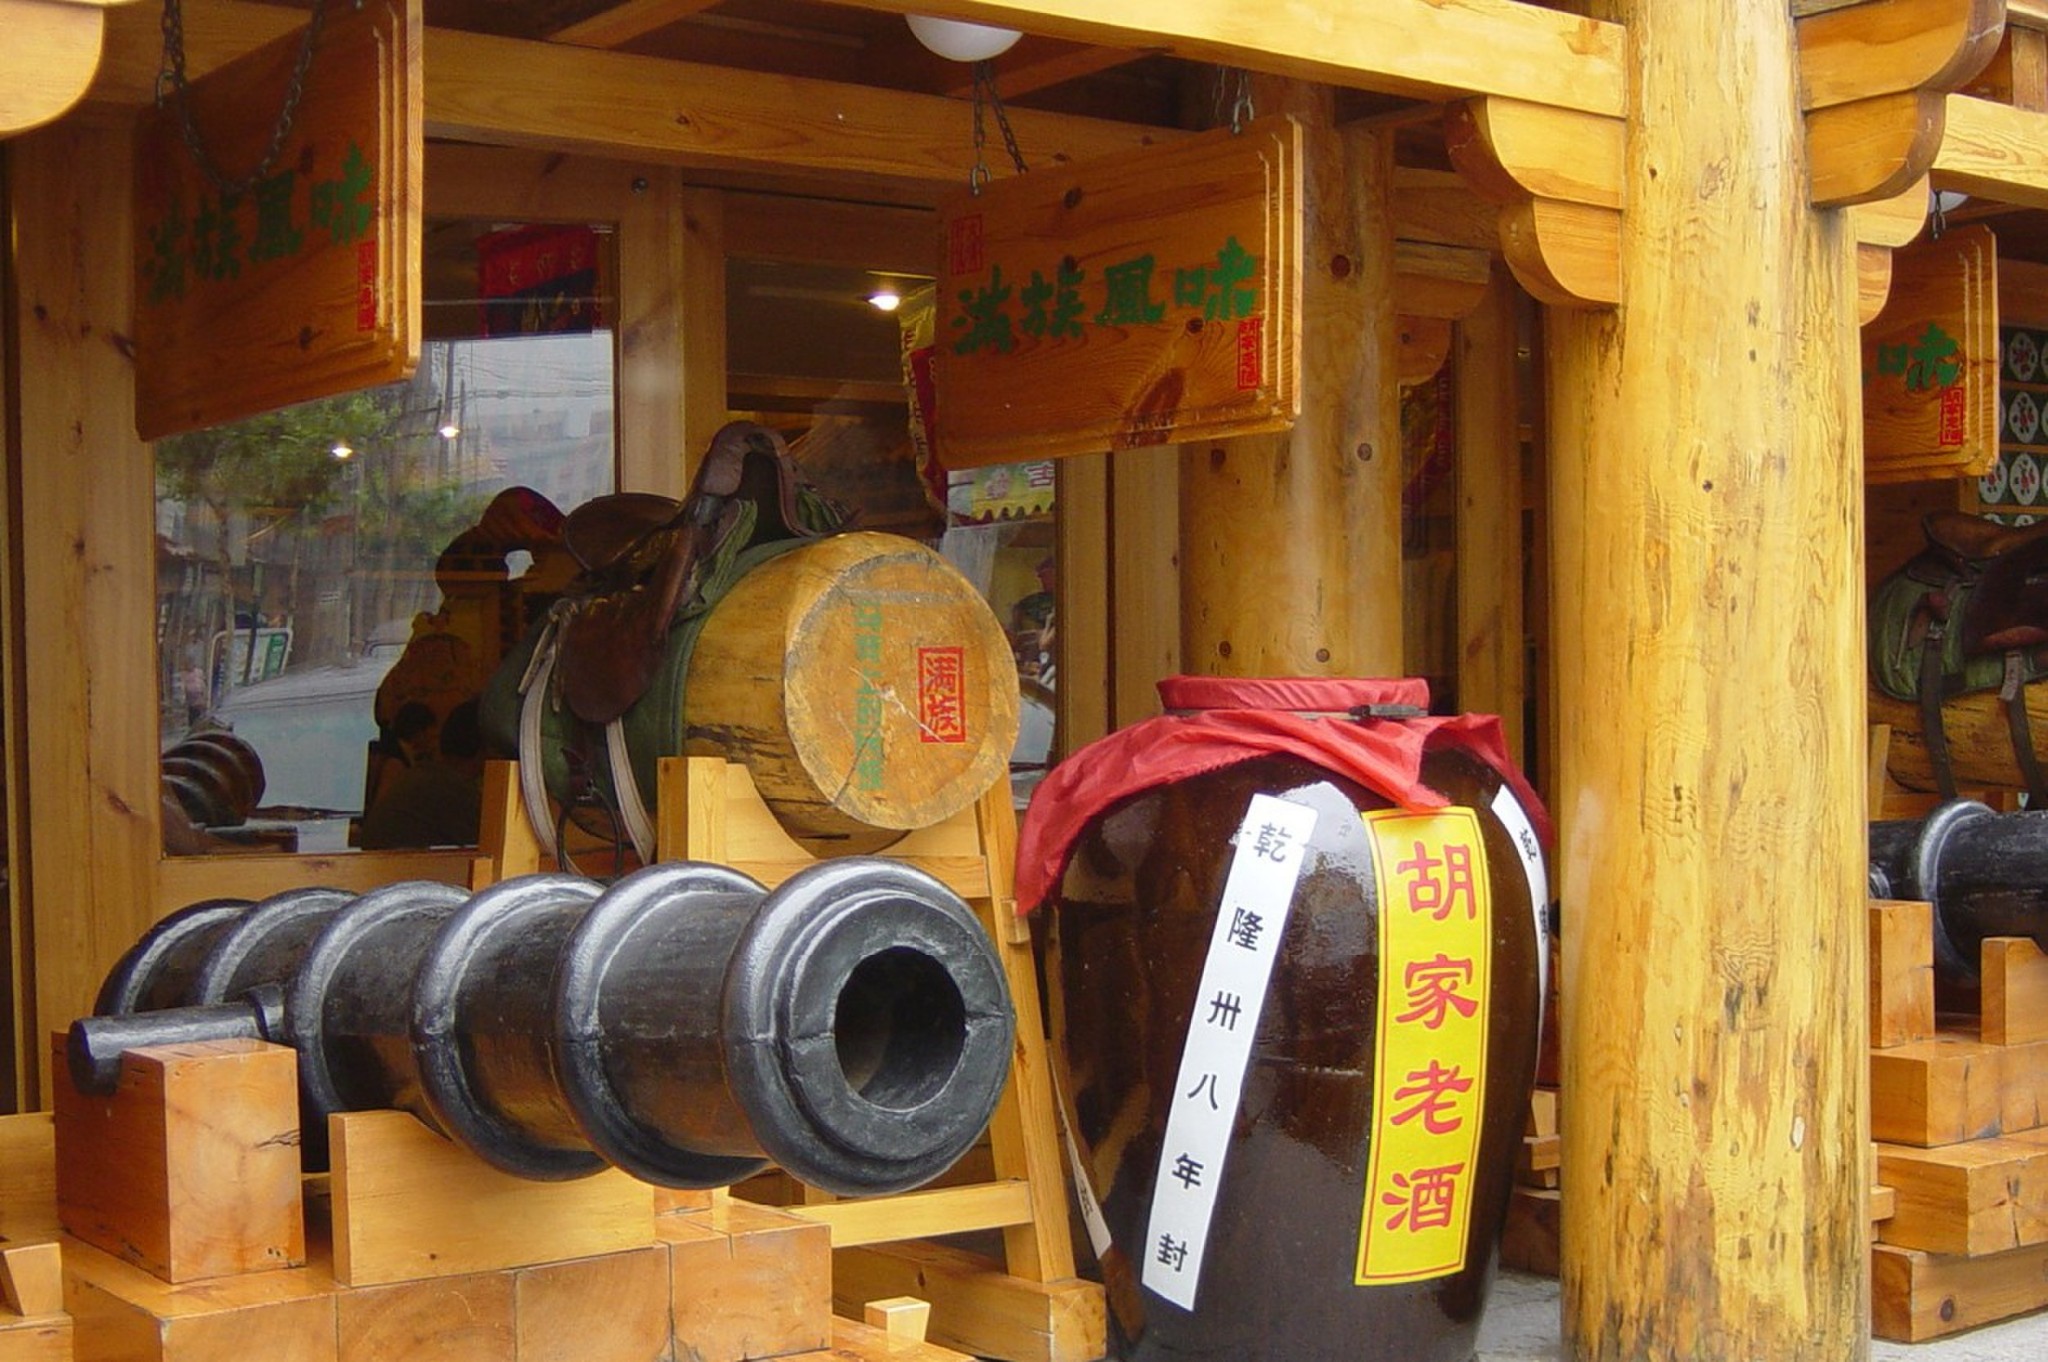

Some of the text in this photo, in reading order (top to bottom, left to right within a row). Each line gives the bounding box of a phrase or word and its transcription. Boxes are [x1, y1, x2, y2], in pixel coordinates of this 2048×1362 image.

[1862, 323, 1959, 391] 味
[1155, 822, 1292, 1273] 乾隆卅八年封
[1382, 840, 1479, 1234] 胡家老酒
